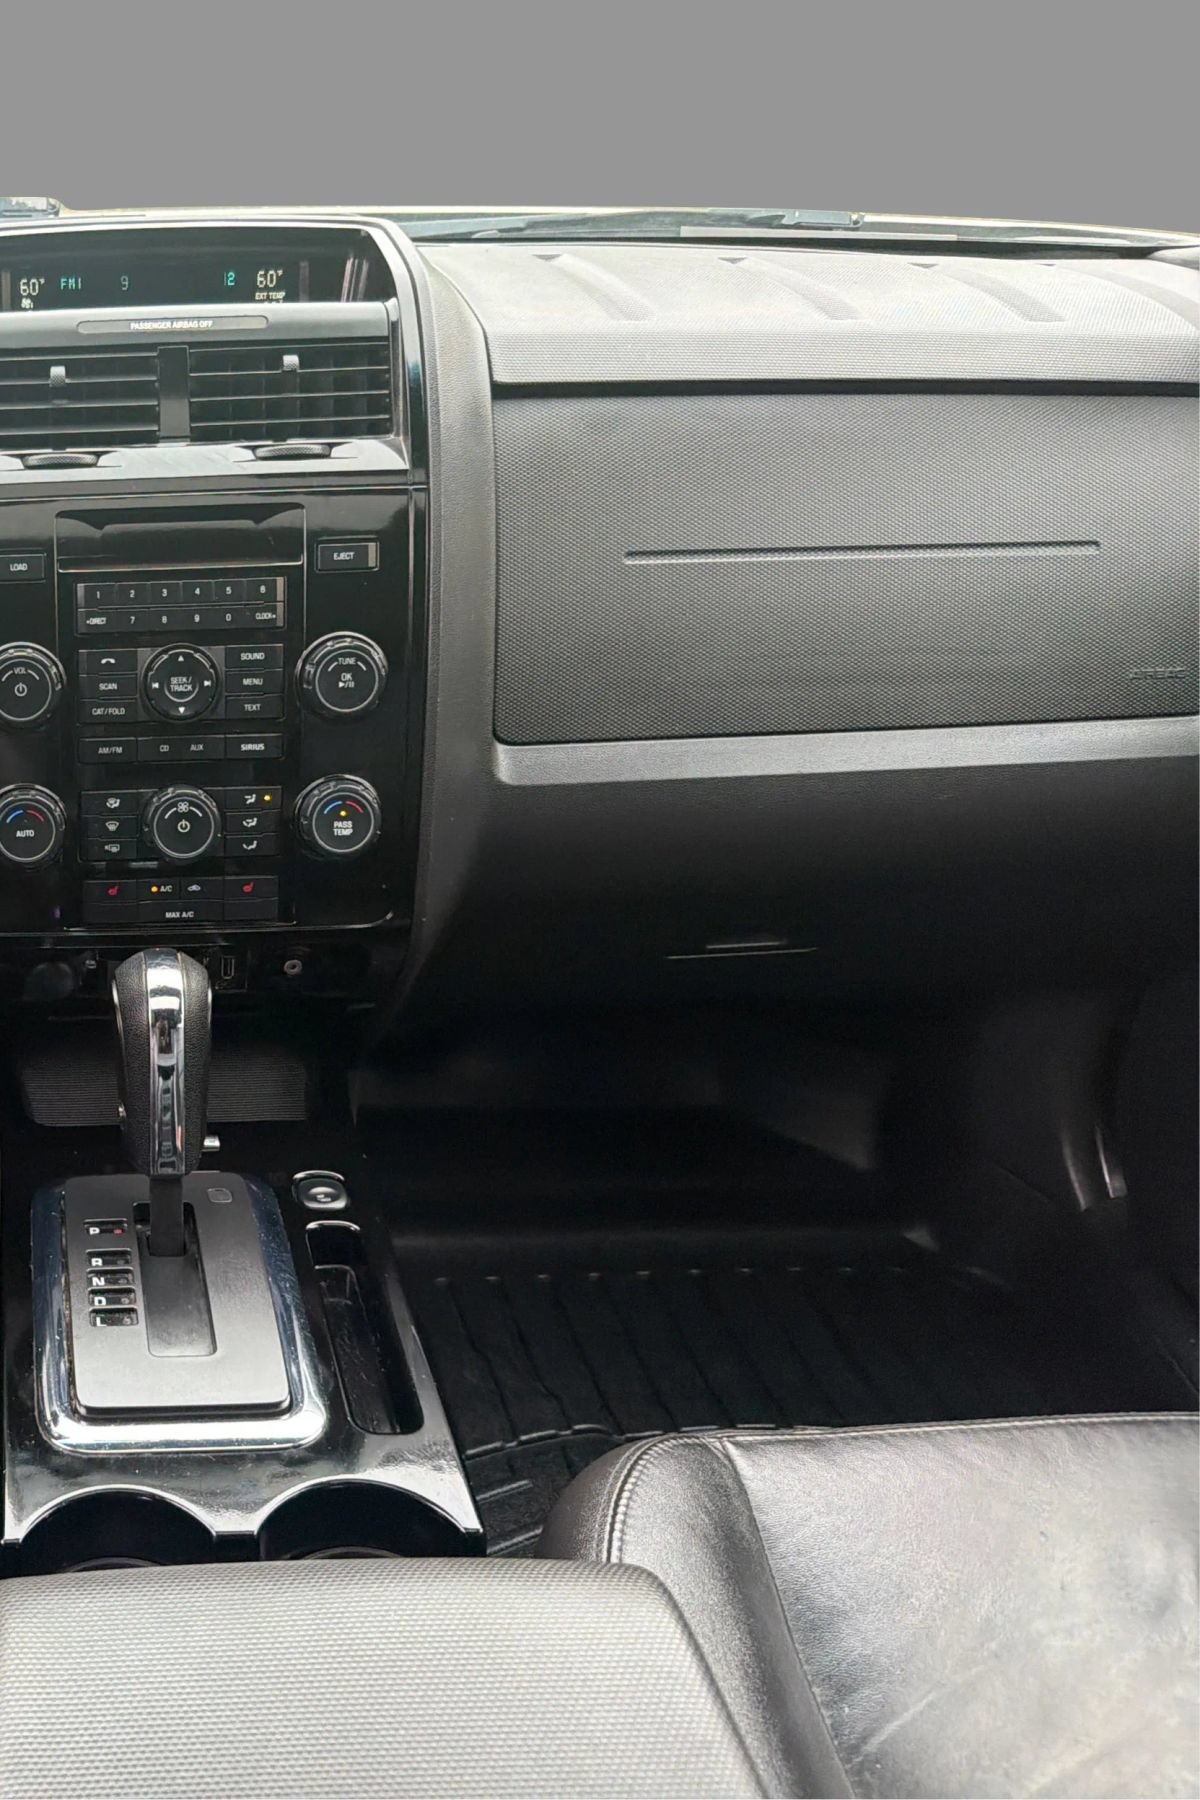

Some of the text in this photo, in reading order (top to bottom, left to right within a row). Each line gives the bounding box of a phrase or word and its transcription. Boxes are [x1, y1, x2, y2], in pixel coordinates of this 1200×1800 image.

[223, 271, 236, 287] 12
[130, 319, 214, 330] PASSENGER AIRBAG OFF
[333, 551, 355, 561] EJECT
[10, 562, 29, 572] LOAD
[129, 590, 136, 598] 2
[161, 588, 168, 597] 3
[194, 587, 201, 596] 4
[225, 586, 232, 595] 5
[130, 616, 136, 625] 7
[161, 615, 168, 624] 8
[194, 614, 200, 623] 9
[225, 613, 232, 622] 0
[240, 652, 265, 661] SOUND
[338, 657, 357, 665] TUNE
[13, 667, 27, 675] VOL
[341, 672, 353, 682] OK
[242, 678, 263, 686] MENU
[98, 683, 118, 691] SCAN
[170, 684, 193, 693] TRACK
[244, 704, 261, 712] TEXT
[98, 746, 123, 755] AM/FM
[159, 744, 170, 752] CD
[190, 743, 204, 752] AUX
[240, 743, 265, 752] SIRIUS
[333, 820, 353, 829] PASS
[16, 829, 35, 838] AUTO
[333, 828, 354, 837] TEMP
[160, 885, 173, 893] A/C
[165, 911, 180, 919] MAX
[89, 1227, 100, 1235] P
[91, 1258, 103, 1267] R
[92, 1276, 105, 1286] N
[94, 1296, 107, 1306] D
[96, 1316, 107, 1327] L
